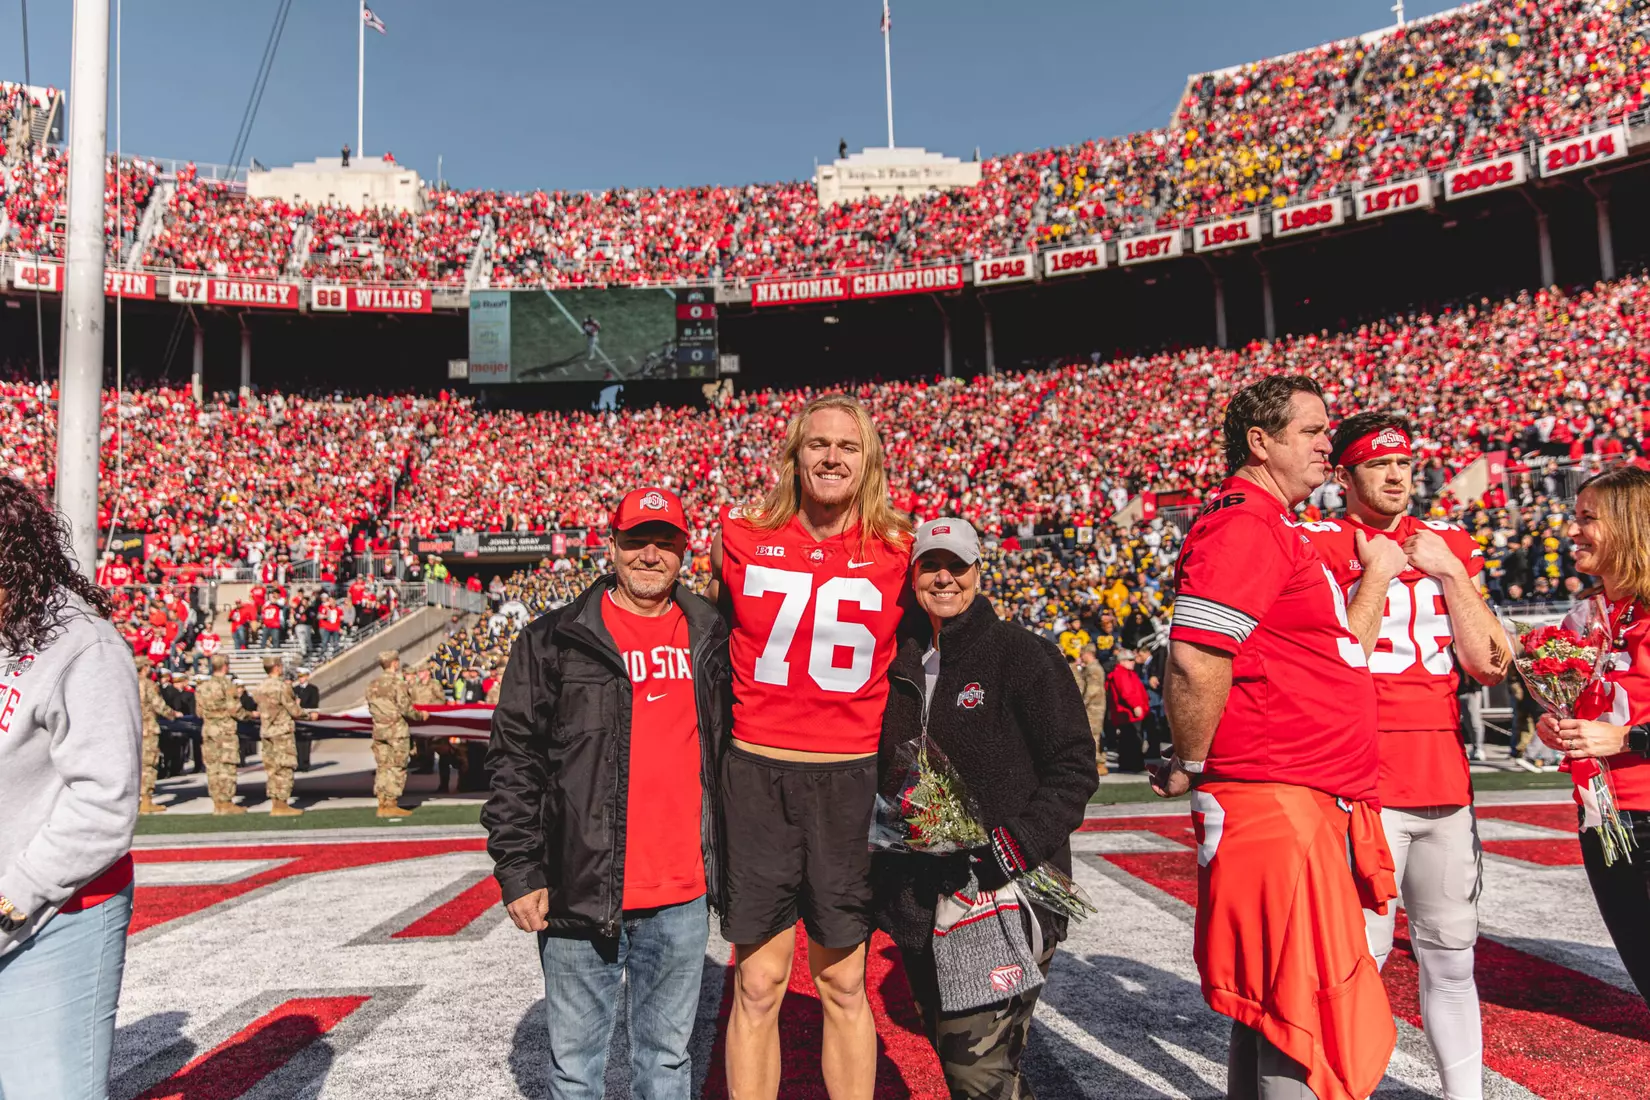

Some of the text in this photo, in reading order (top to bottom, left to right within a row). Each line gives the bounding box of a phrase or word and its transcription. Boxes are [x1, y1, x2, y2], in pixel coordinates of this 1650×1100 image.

[1546, 134, 1615, 171] 2014
[1451, 161, 1514, 194] 2002
[1362, 184, 1419, 215] 1970
[1279, 204, 1333, 232] 1968
[1201, 221, 1250, 247] 1961
[1050, 248, 1098, 273] 1954
[1124, 236, 1173, 261] 1957
[980, 260, 1026, 282] 1942
[175, 280, 291, 304] 47 HARLEY
[756, 266, 960, 302] NATIONAL CHAMPIONS
[354, 289, 423, 309] WILLIS
[690, 305, 702, 318] 0
[691, 349, 703, 361] 0
[471, 363, 509, 375] meijer
[488, 538, 509, 546] JOHN
[518, 537, 541, 546] GRAY
[743, 564, 884, 693] 76
